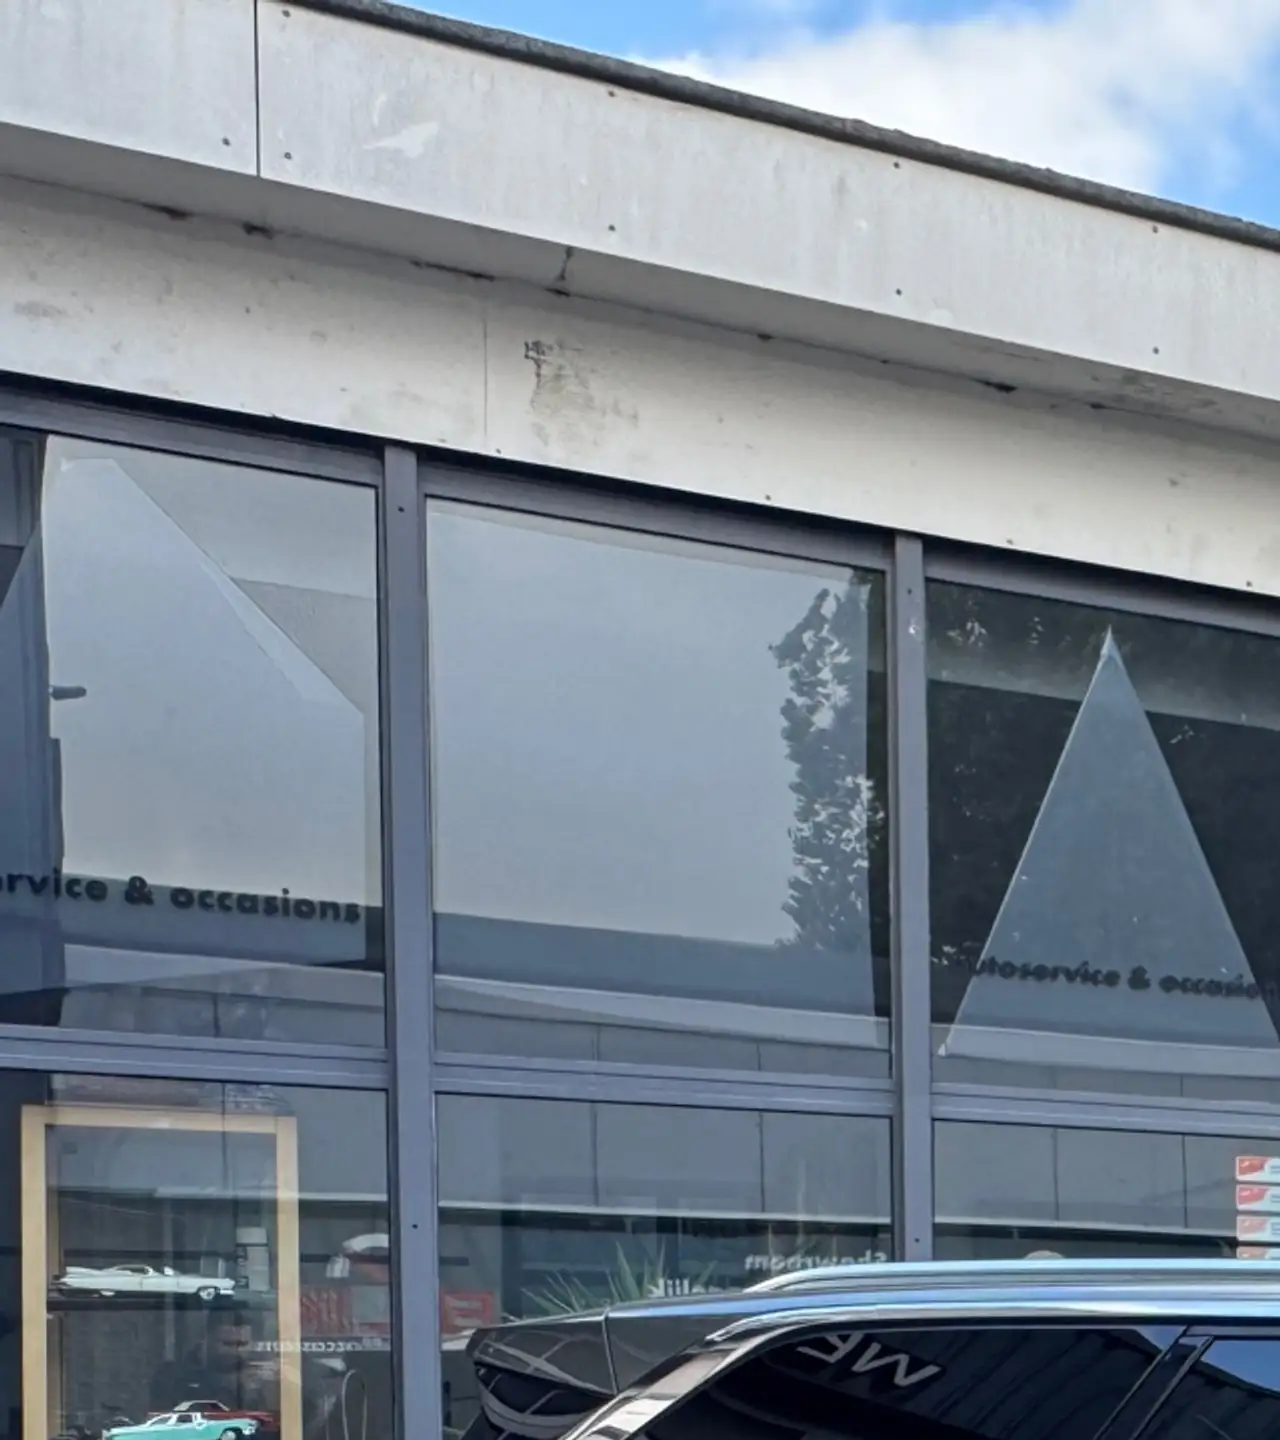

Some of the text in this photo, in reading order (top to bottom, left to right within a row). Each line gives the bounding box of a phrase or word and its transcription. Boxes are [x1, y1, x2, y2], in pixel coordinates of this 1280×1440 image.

[0, 866, 362, 924] rvice & occasions
